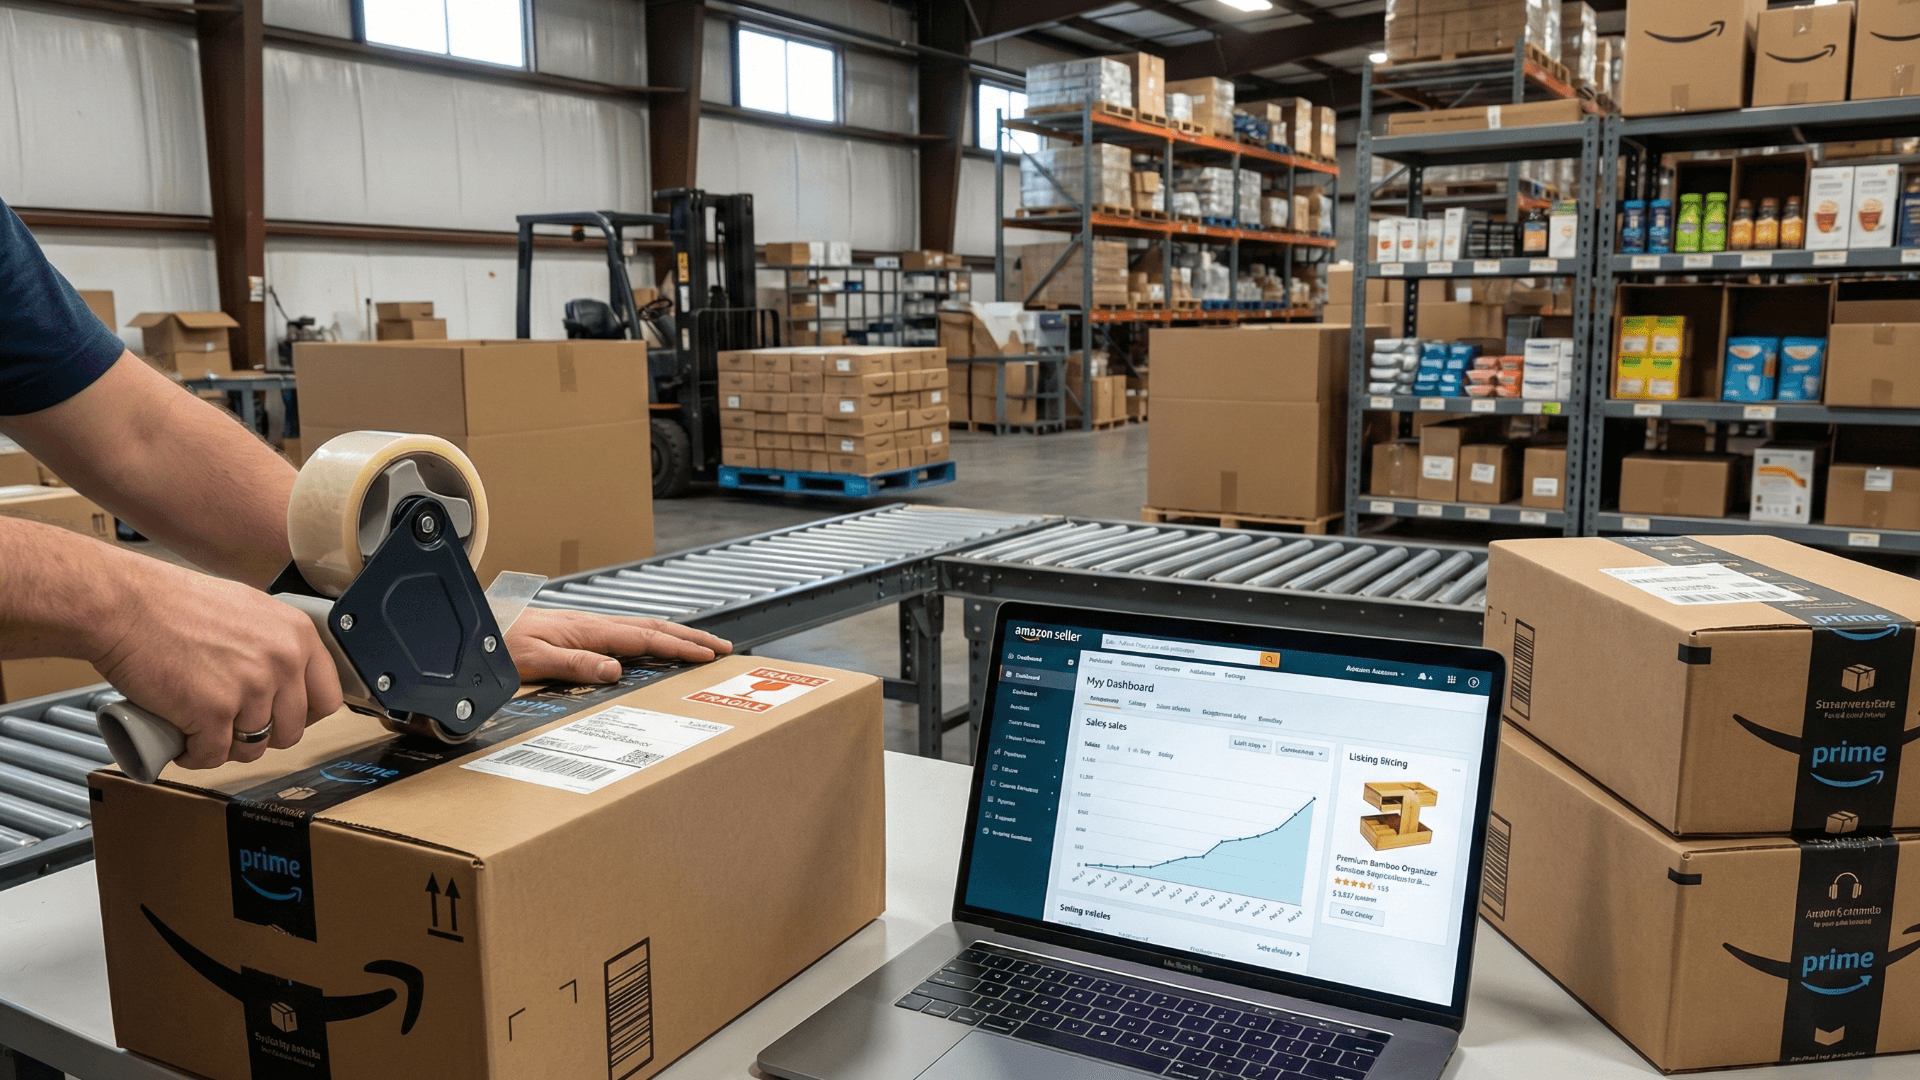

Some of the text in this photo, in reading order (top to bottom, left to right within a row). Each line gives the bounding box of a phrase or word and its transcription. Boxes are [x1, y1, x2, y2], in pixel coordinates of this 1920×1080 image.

[1811, 613, 1893, 626] prime
[1015, 626, 1082, 642] amazon seller
[755, 670, 820, 686] FRAGILE
[1086, 676, 1154, 693] Myy Dashboard
[695, 694, 766, 710] FRAGILE
[1108, 722, 1127, 731] sales
[1812, 740, 1888, 768] prime
[325, 760, 398, 778] prime
[240, 846, 300, 878] prime
[1337, 854, 1438, 876] Premium Bamboo Organizer
[1802, 948, 1874, 978] prime
